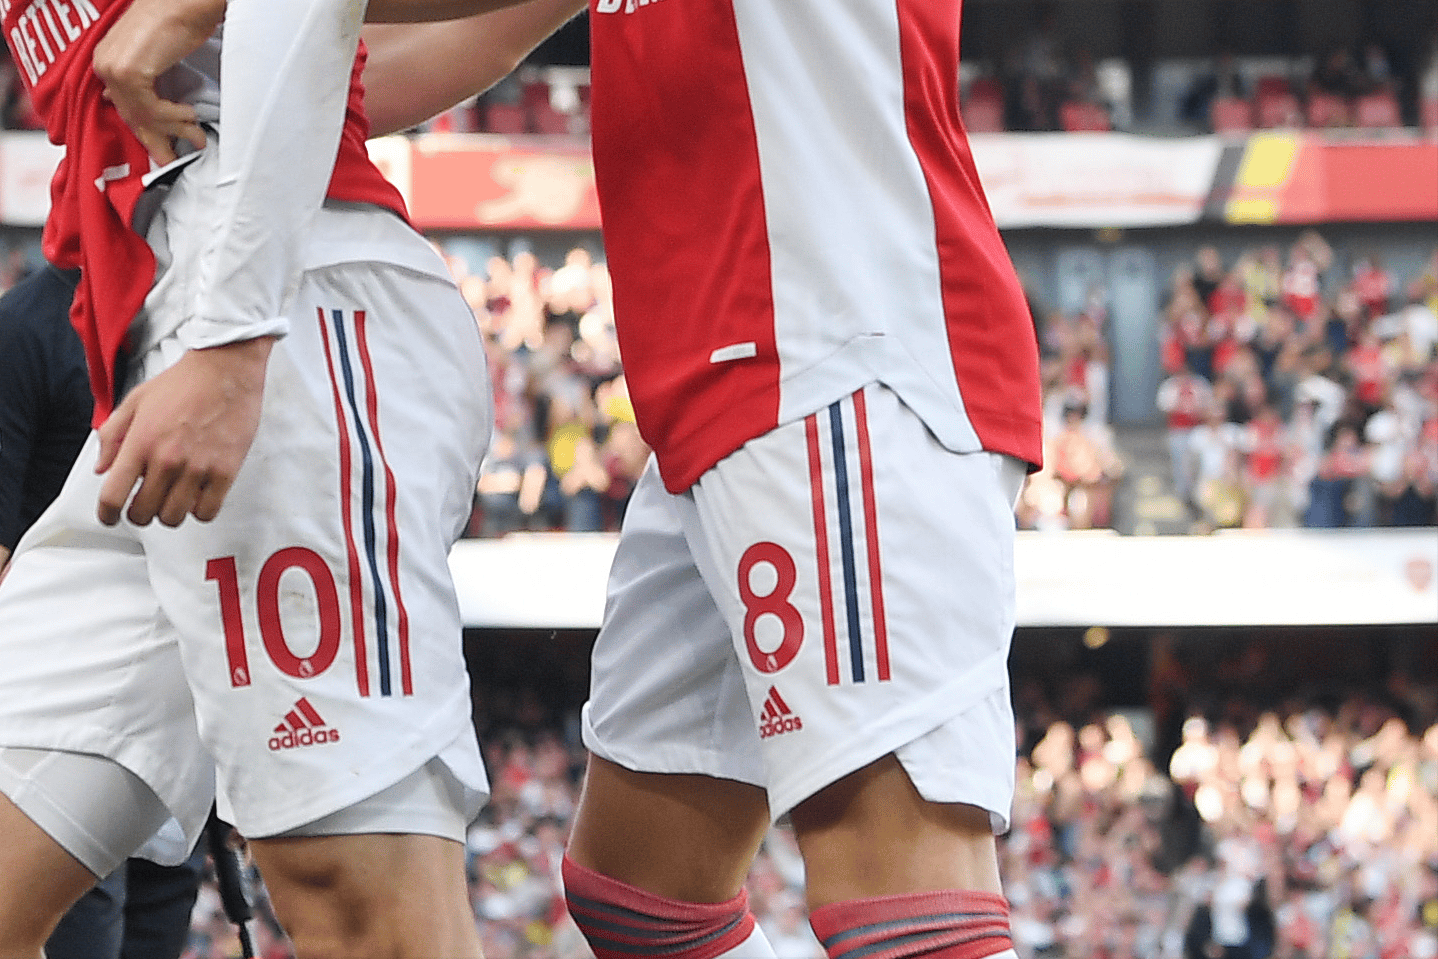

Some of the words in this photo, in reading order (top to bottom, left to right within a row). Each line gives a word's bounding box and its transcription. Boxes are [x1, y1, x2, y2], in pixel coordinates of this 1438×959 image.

[205, 545, 342, 689] 10
[736, 540, 806, 675] 8
[268, 728, 341, 752] adidas
